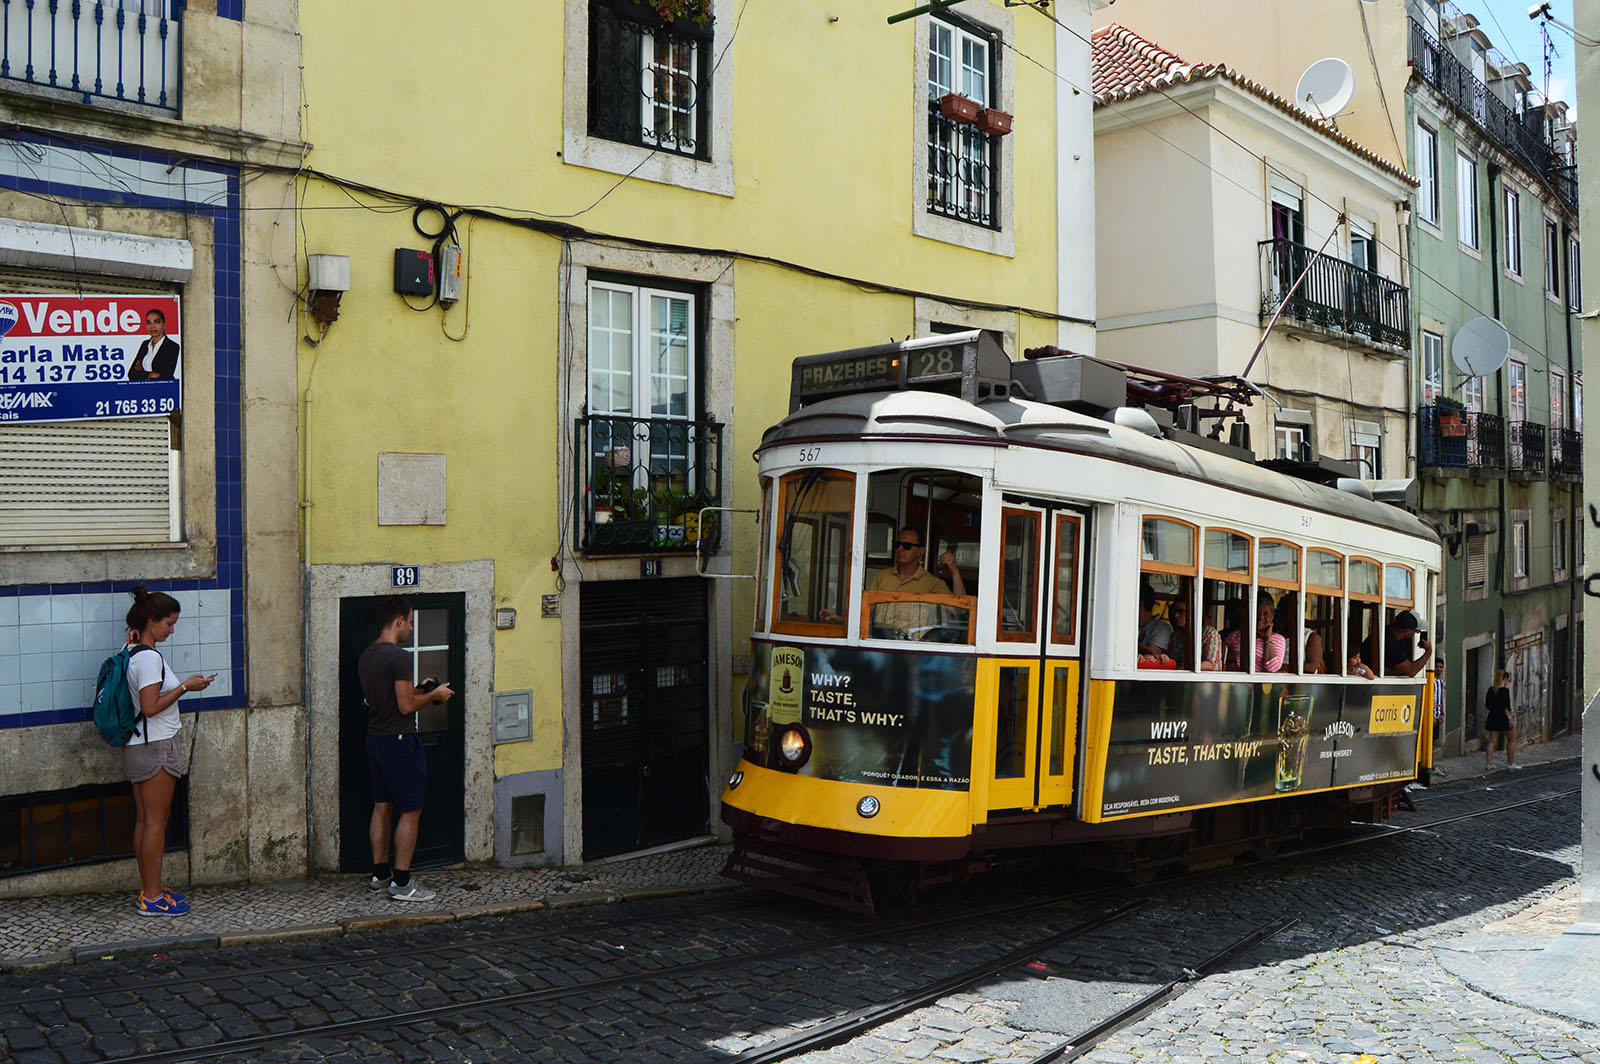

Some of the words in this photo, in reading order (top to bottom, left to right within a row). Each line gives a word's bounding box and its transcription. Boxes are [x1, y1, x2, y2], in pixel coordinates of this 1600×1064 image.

[21, 302, 141, 334] Vende
[62, 344, 125, 362] Mata
[921, 348, 954, 376] 28
[36, 365, 77, 382] 137
[85, 363, 125, 380] 589
[803, 357, 888, 385] PRAZERES
[0, 411, 19, 420] ais
[96, 401, 110, 415] 21
[115, 400, 138, 414] 765
[141, 399, 156, 413] 33
[159, 398, 174, 412] 50
[799, 447, 821, 462] 567
[1301, 515, 1312, 528] 567
[396, 567, 415, 586] 89
[646, 560, 657, 576] 91
[811, 672, 851, 688] WHY?
[810, 689, 857, 708] TASTE,
[809, 706, 857, 723] THAT'S
[1375, 704, 1398, 722] carris
[1150, 720, 1188, 740] WHY?
[1323, 720, 1355, 741] JAMESON
[1147, 745, 1189, 766] TASTE,
[1193, 742, 1231, 762] THAT'S
[1320, 751, 1333, 759] IRISH
[1333, 749, 1353, 758] WHISKEY
